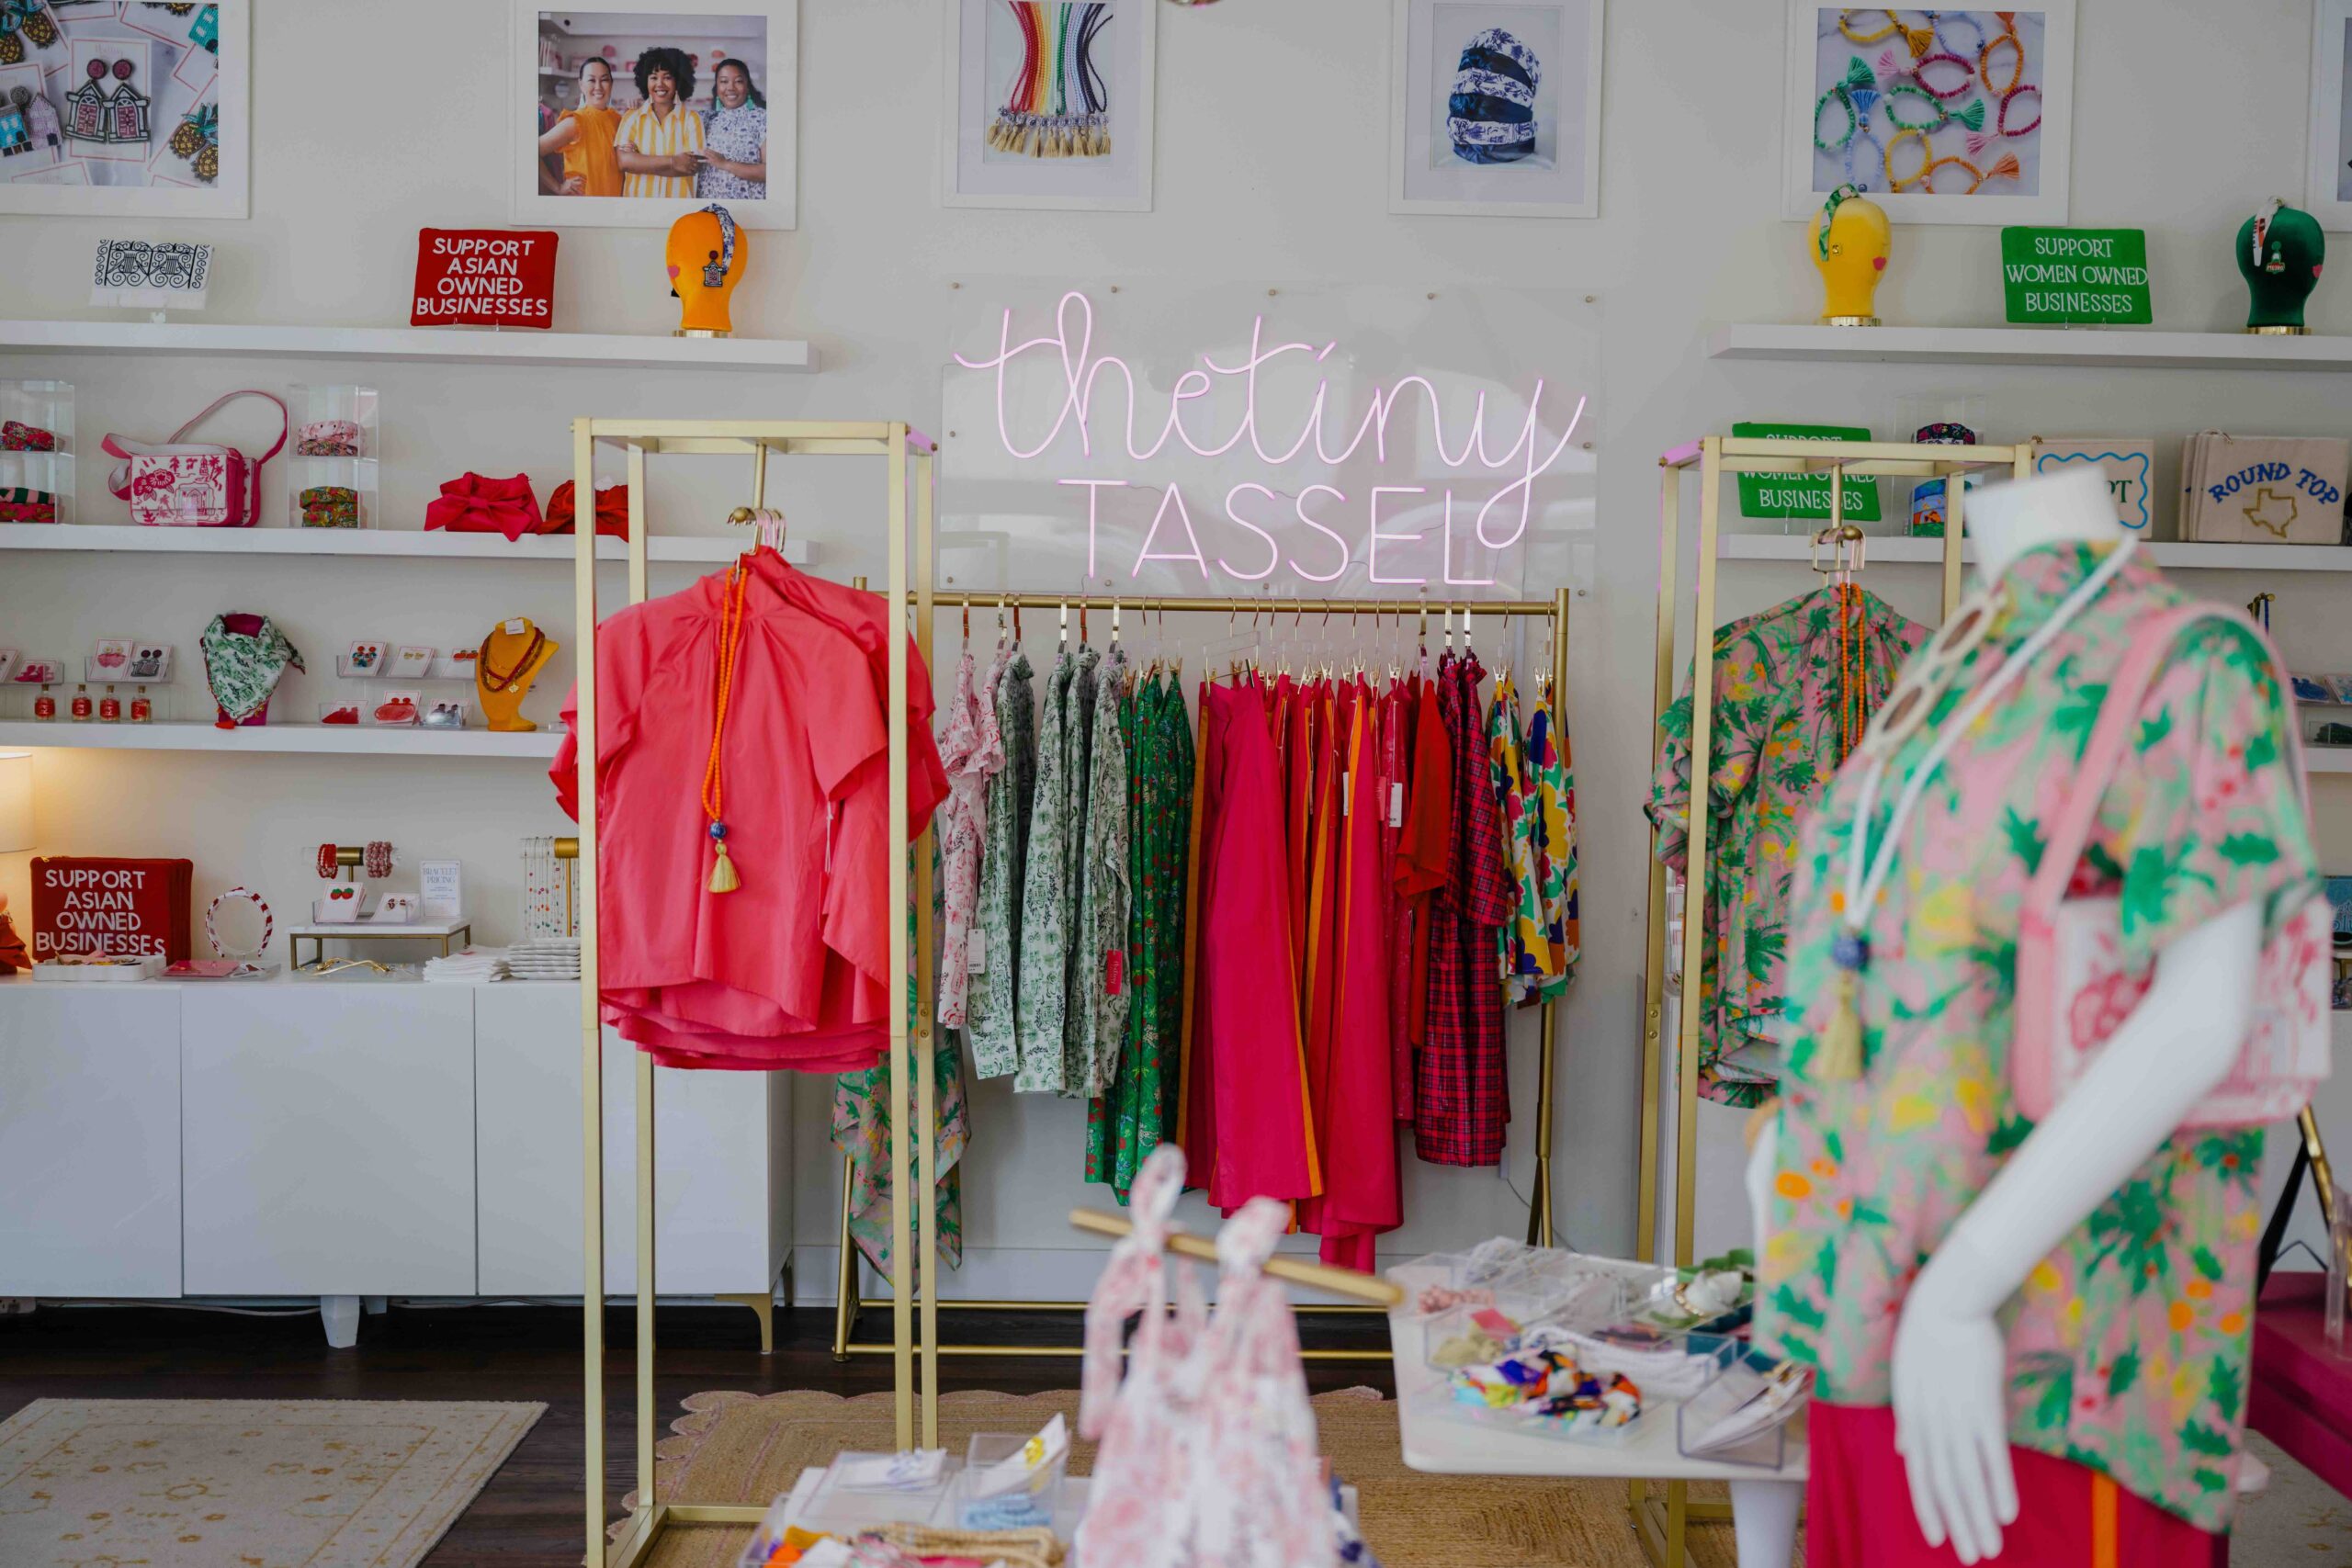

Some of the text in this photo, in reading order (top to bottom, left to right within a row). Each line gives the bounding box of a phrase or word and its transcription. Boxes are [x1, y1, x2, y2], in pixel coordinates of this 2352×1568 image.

[433, 237, 535, 256] SUPPORT
[2035, 237, 2113, 258] SUPPORT
[447, 257, 518, 276] ASIAN
[2006, 264, 2148, 286] WOMEN OWNED
[437, 276, 524, 295] OWNED
[416, 297, 548, 316] BUSINESSES
[2025, 292, 2132, 313] BUSINESSES
[2208, 462, 2339, 504] ROUND TOP
[1758, 488, 1863, 511] BUSINESES
[1057, 479, 1496, 585] TASSEL
[45, 869, 146, 889] SUPPORT
[63, 891, 134, 910] ASIAN
[56, 911, 141, 931] OWNED
[36, 931, 166, 956] BUSINESSES
